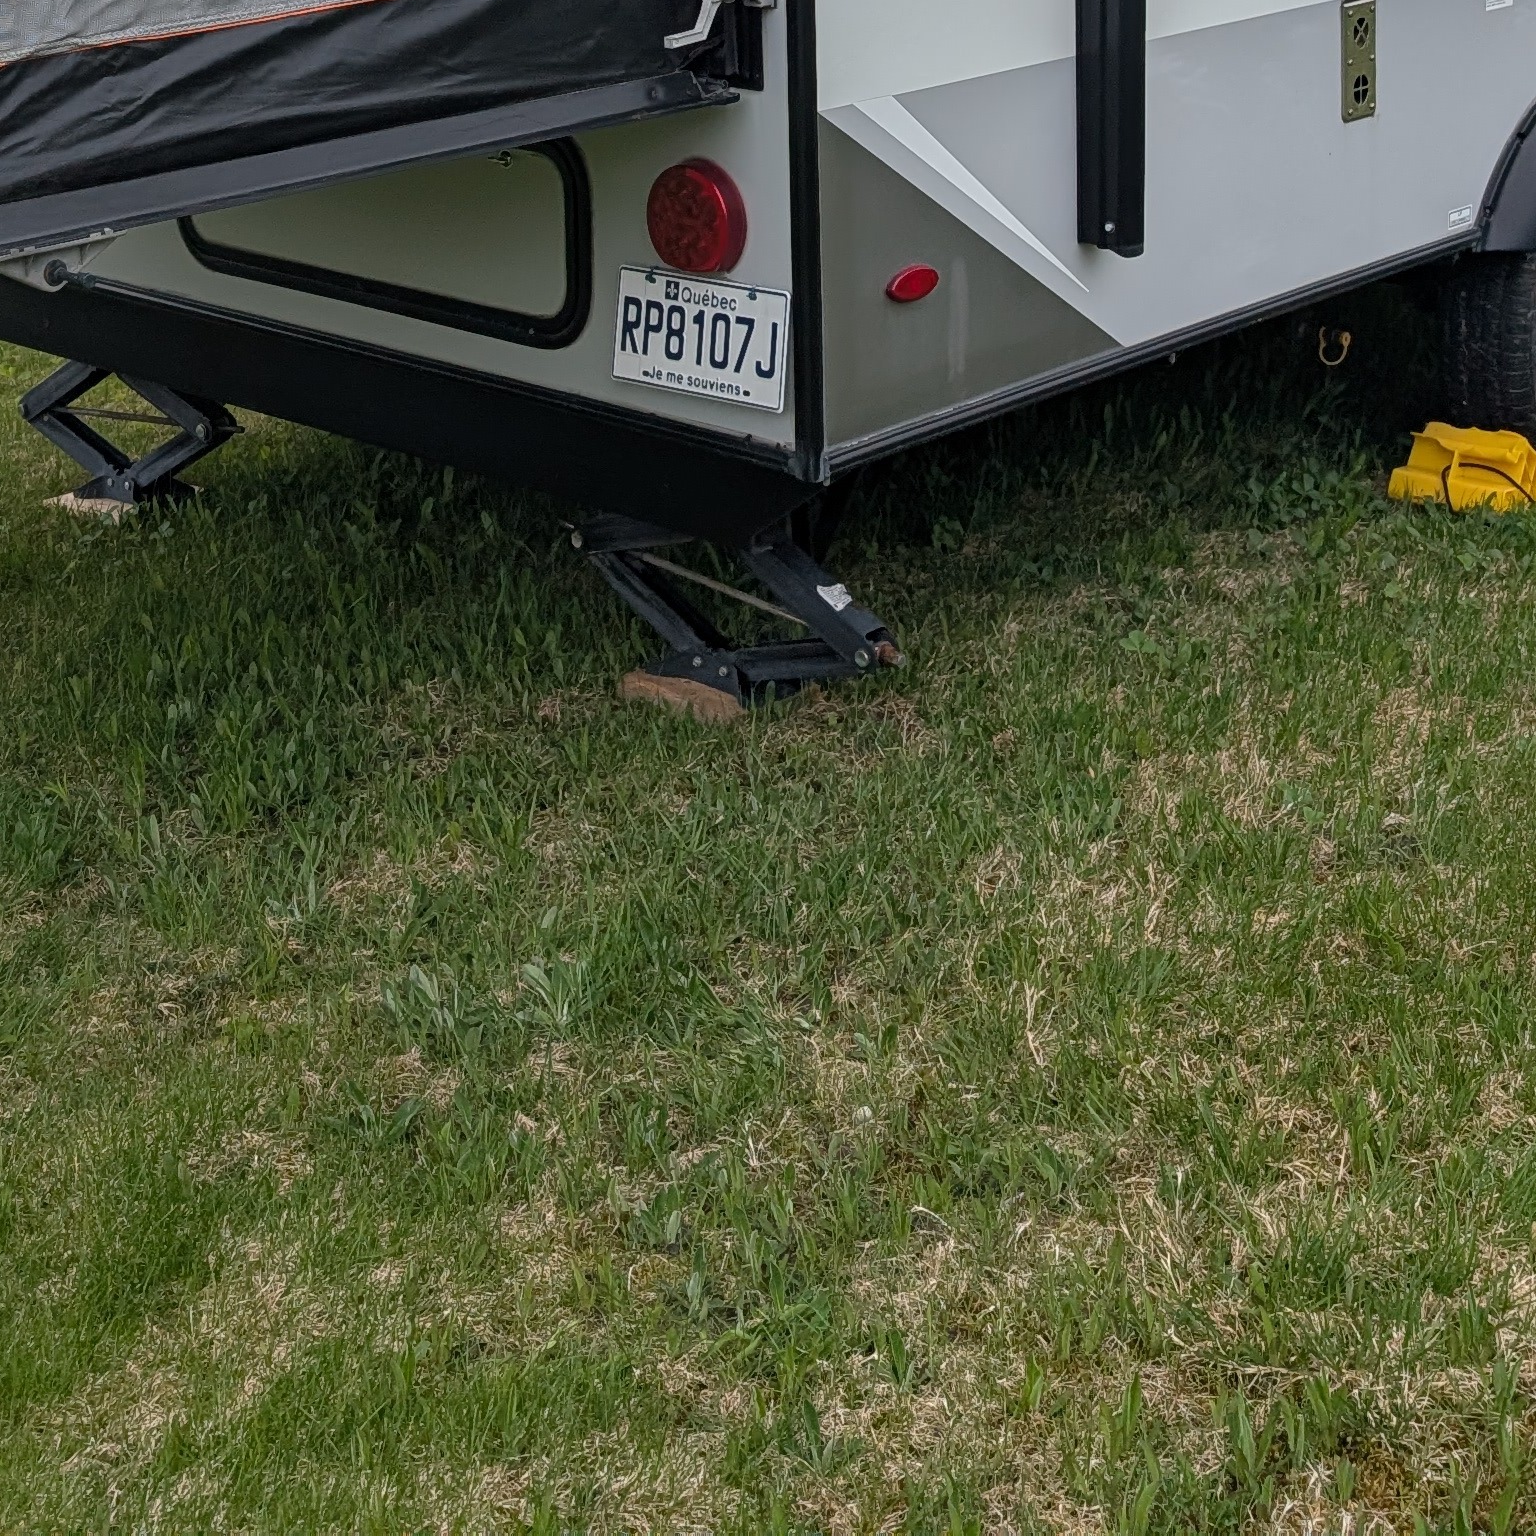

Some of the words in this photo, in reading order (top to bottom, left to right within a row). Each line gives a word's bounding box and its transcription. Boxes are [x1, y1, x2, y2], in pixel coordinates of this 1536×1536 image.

[681, 286, 737, 311] Québec
[620, 295, 779, 379] RP8107J
[648, 366, 664, 380] Je
[666, 371, 684, 385] me
[687, 374, 741, 396] souviens
